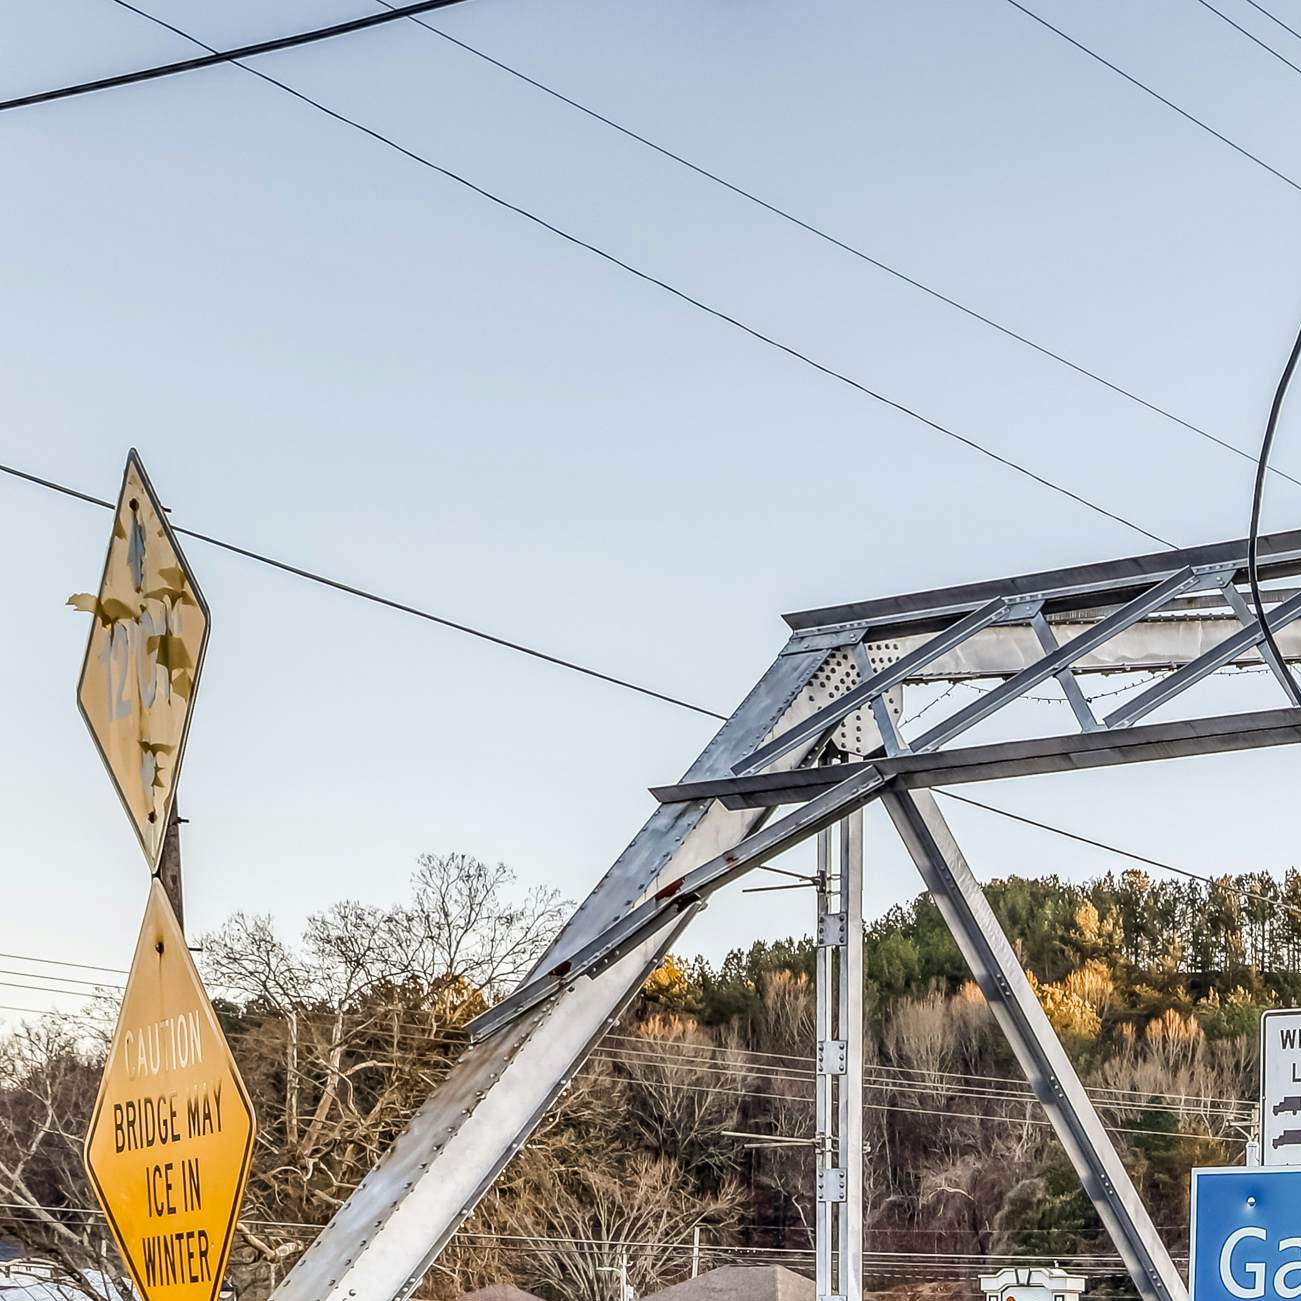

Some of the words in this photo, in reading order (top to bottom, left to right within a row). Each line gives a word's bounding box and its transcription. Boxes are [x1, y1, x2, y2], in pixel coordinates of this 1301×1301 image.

[124, 1009, 203, 1082] CAUTION
[114, 1091, 181, 1153] BRIDGE
[187, 1078, 223, 1140] MAY
[146, 1162, 177, 1218] ICE
[181, 1157, 202, 1213] IN
[142, 1230, 212, 1287] WINTER
